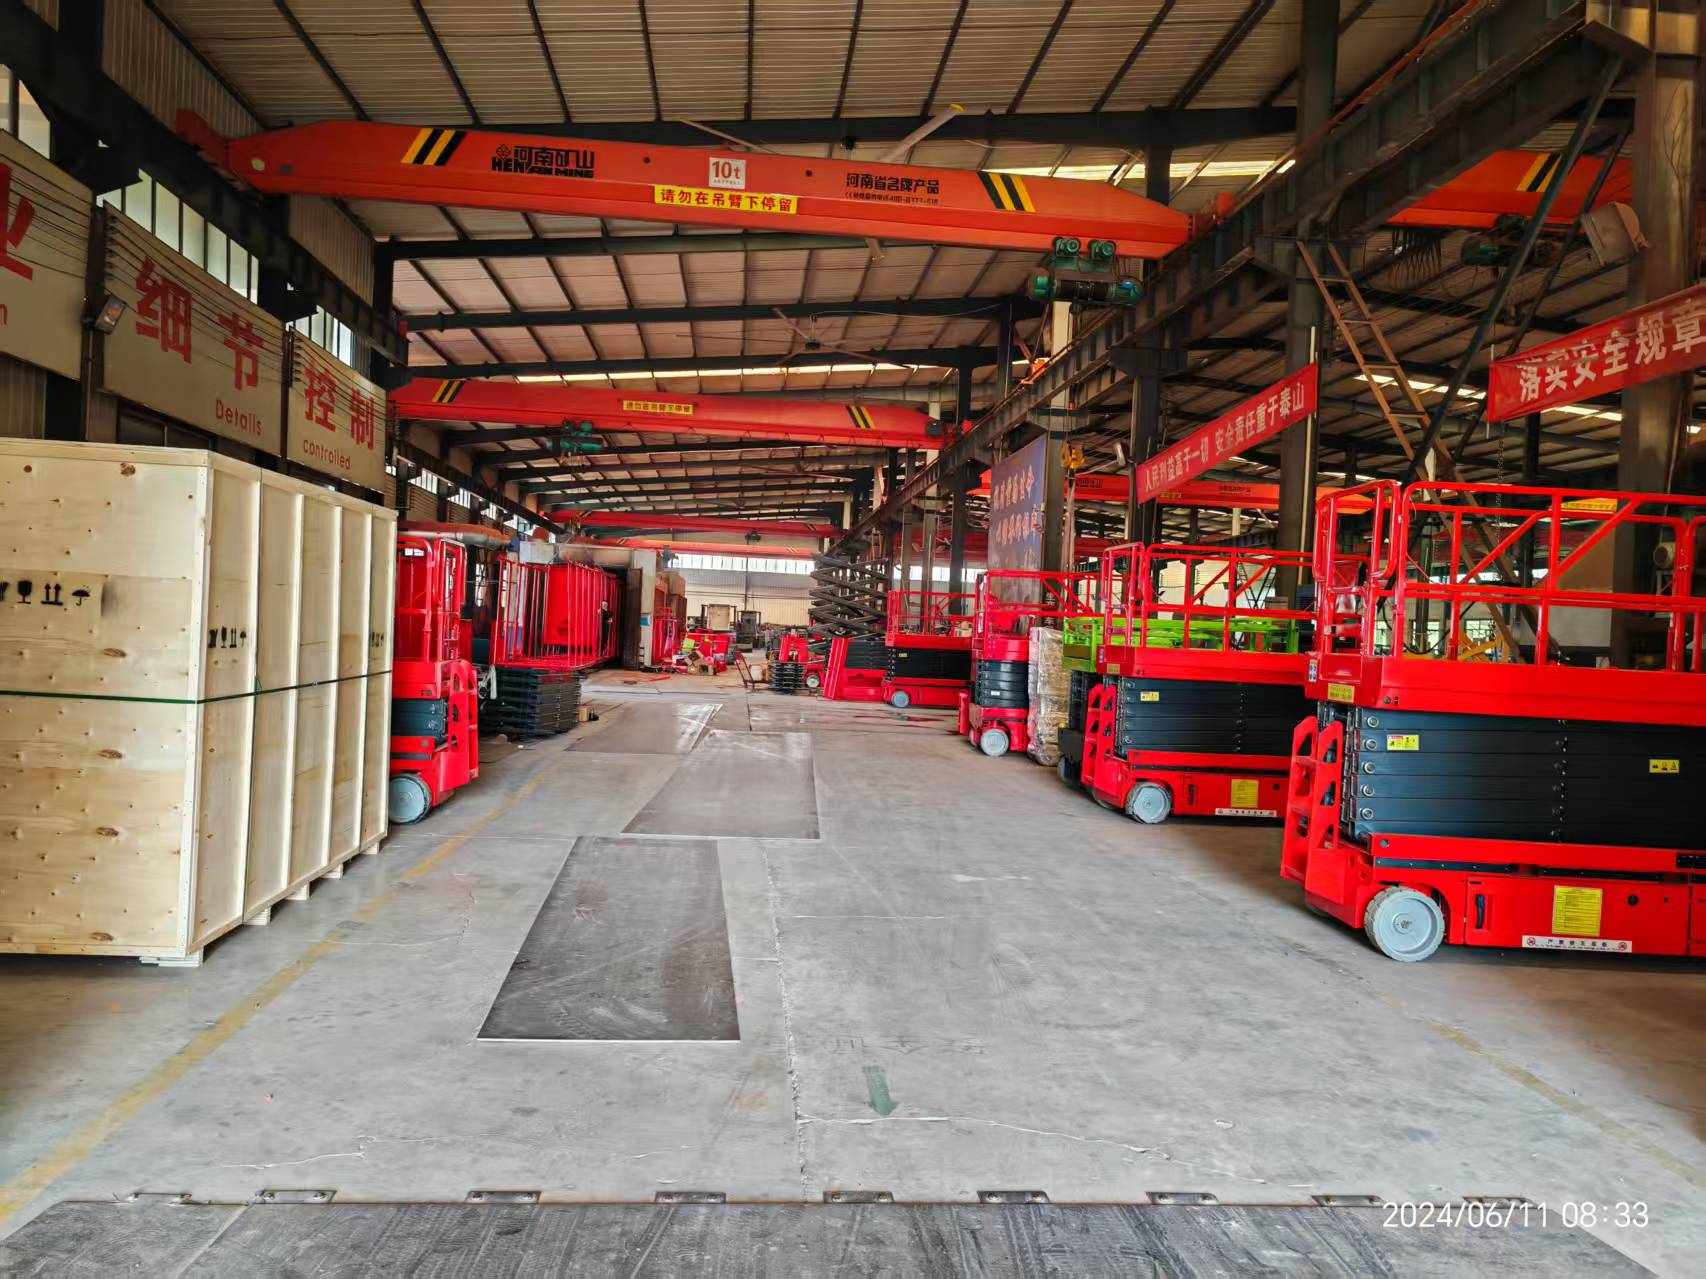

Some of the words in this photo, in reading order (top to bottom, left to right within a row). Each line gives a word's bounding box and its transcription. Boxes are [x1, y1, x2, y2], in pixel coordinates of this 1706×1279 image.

[512, 145, 595, 169] 河南矿山
[711, 160, 741, 180] 10t
[846, 172, 940, 195] 河南省名牌产品
[660, 188, 793, 213] 请勿在吊臂下停留
[136, 256, 264, 391] 细节
[215, 399, 263, 437] Details
[303, 356, 375, 451] 控制
[1215, 382, 1305, 456] 安全责任重于泰山
[303, 438, 351, 471] controlled
